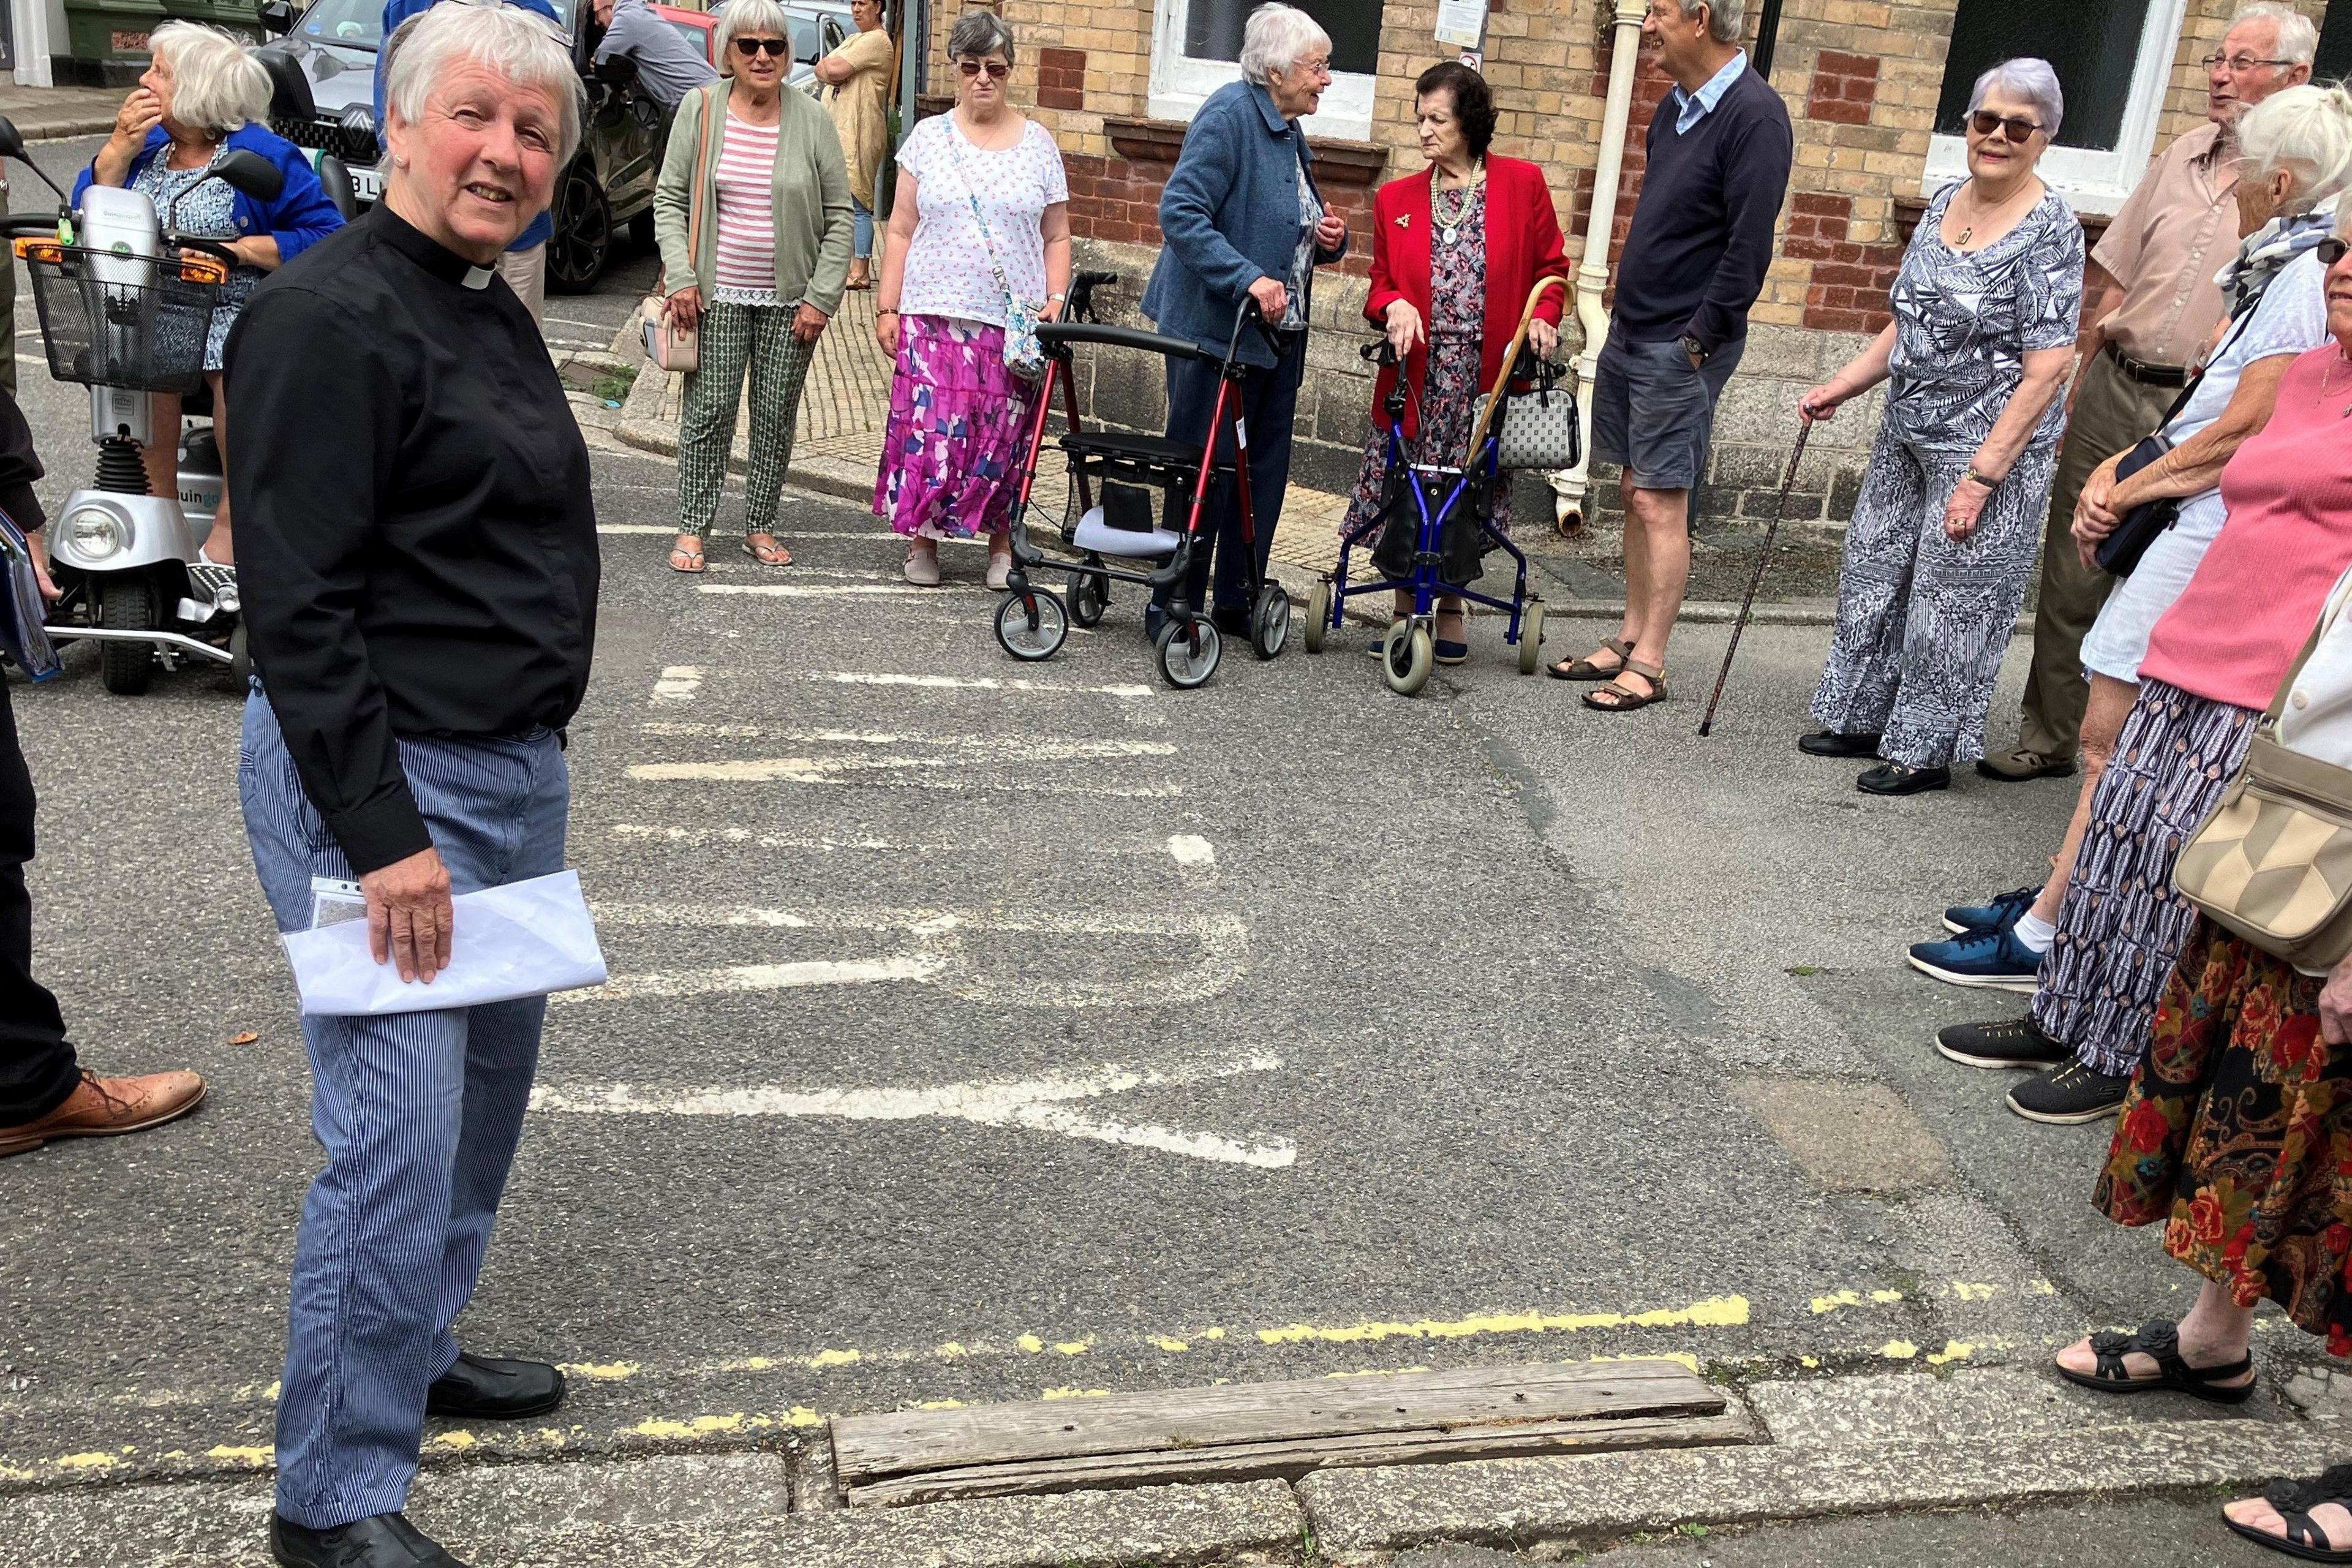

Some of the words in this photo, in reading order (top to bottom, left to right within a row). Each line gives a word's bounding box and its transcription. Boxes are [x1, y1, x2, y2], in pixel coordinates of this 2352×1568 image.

[352, 175, 361, 192] 3
[367, 178, 382, 195] L
[176, 489, 219, 508] uingo
